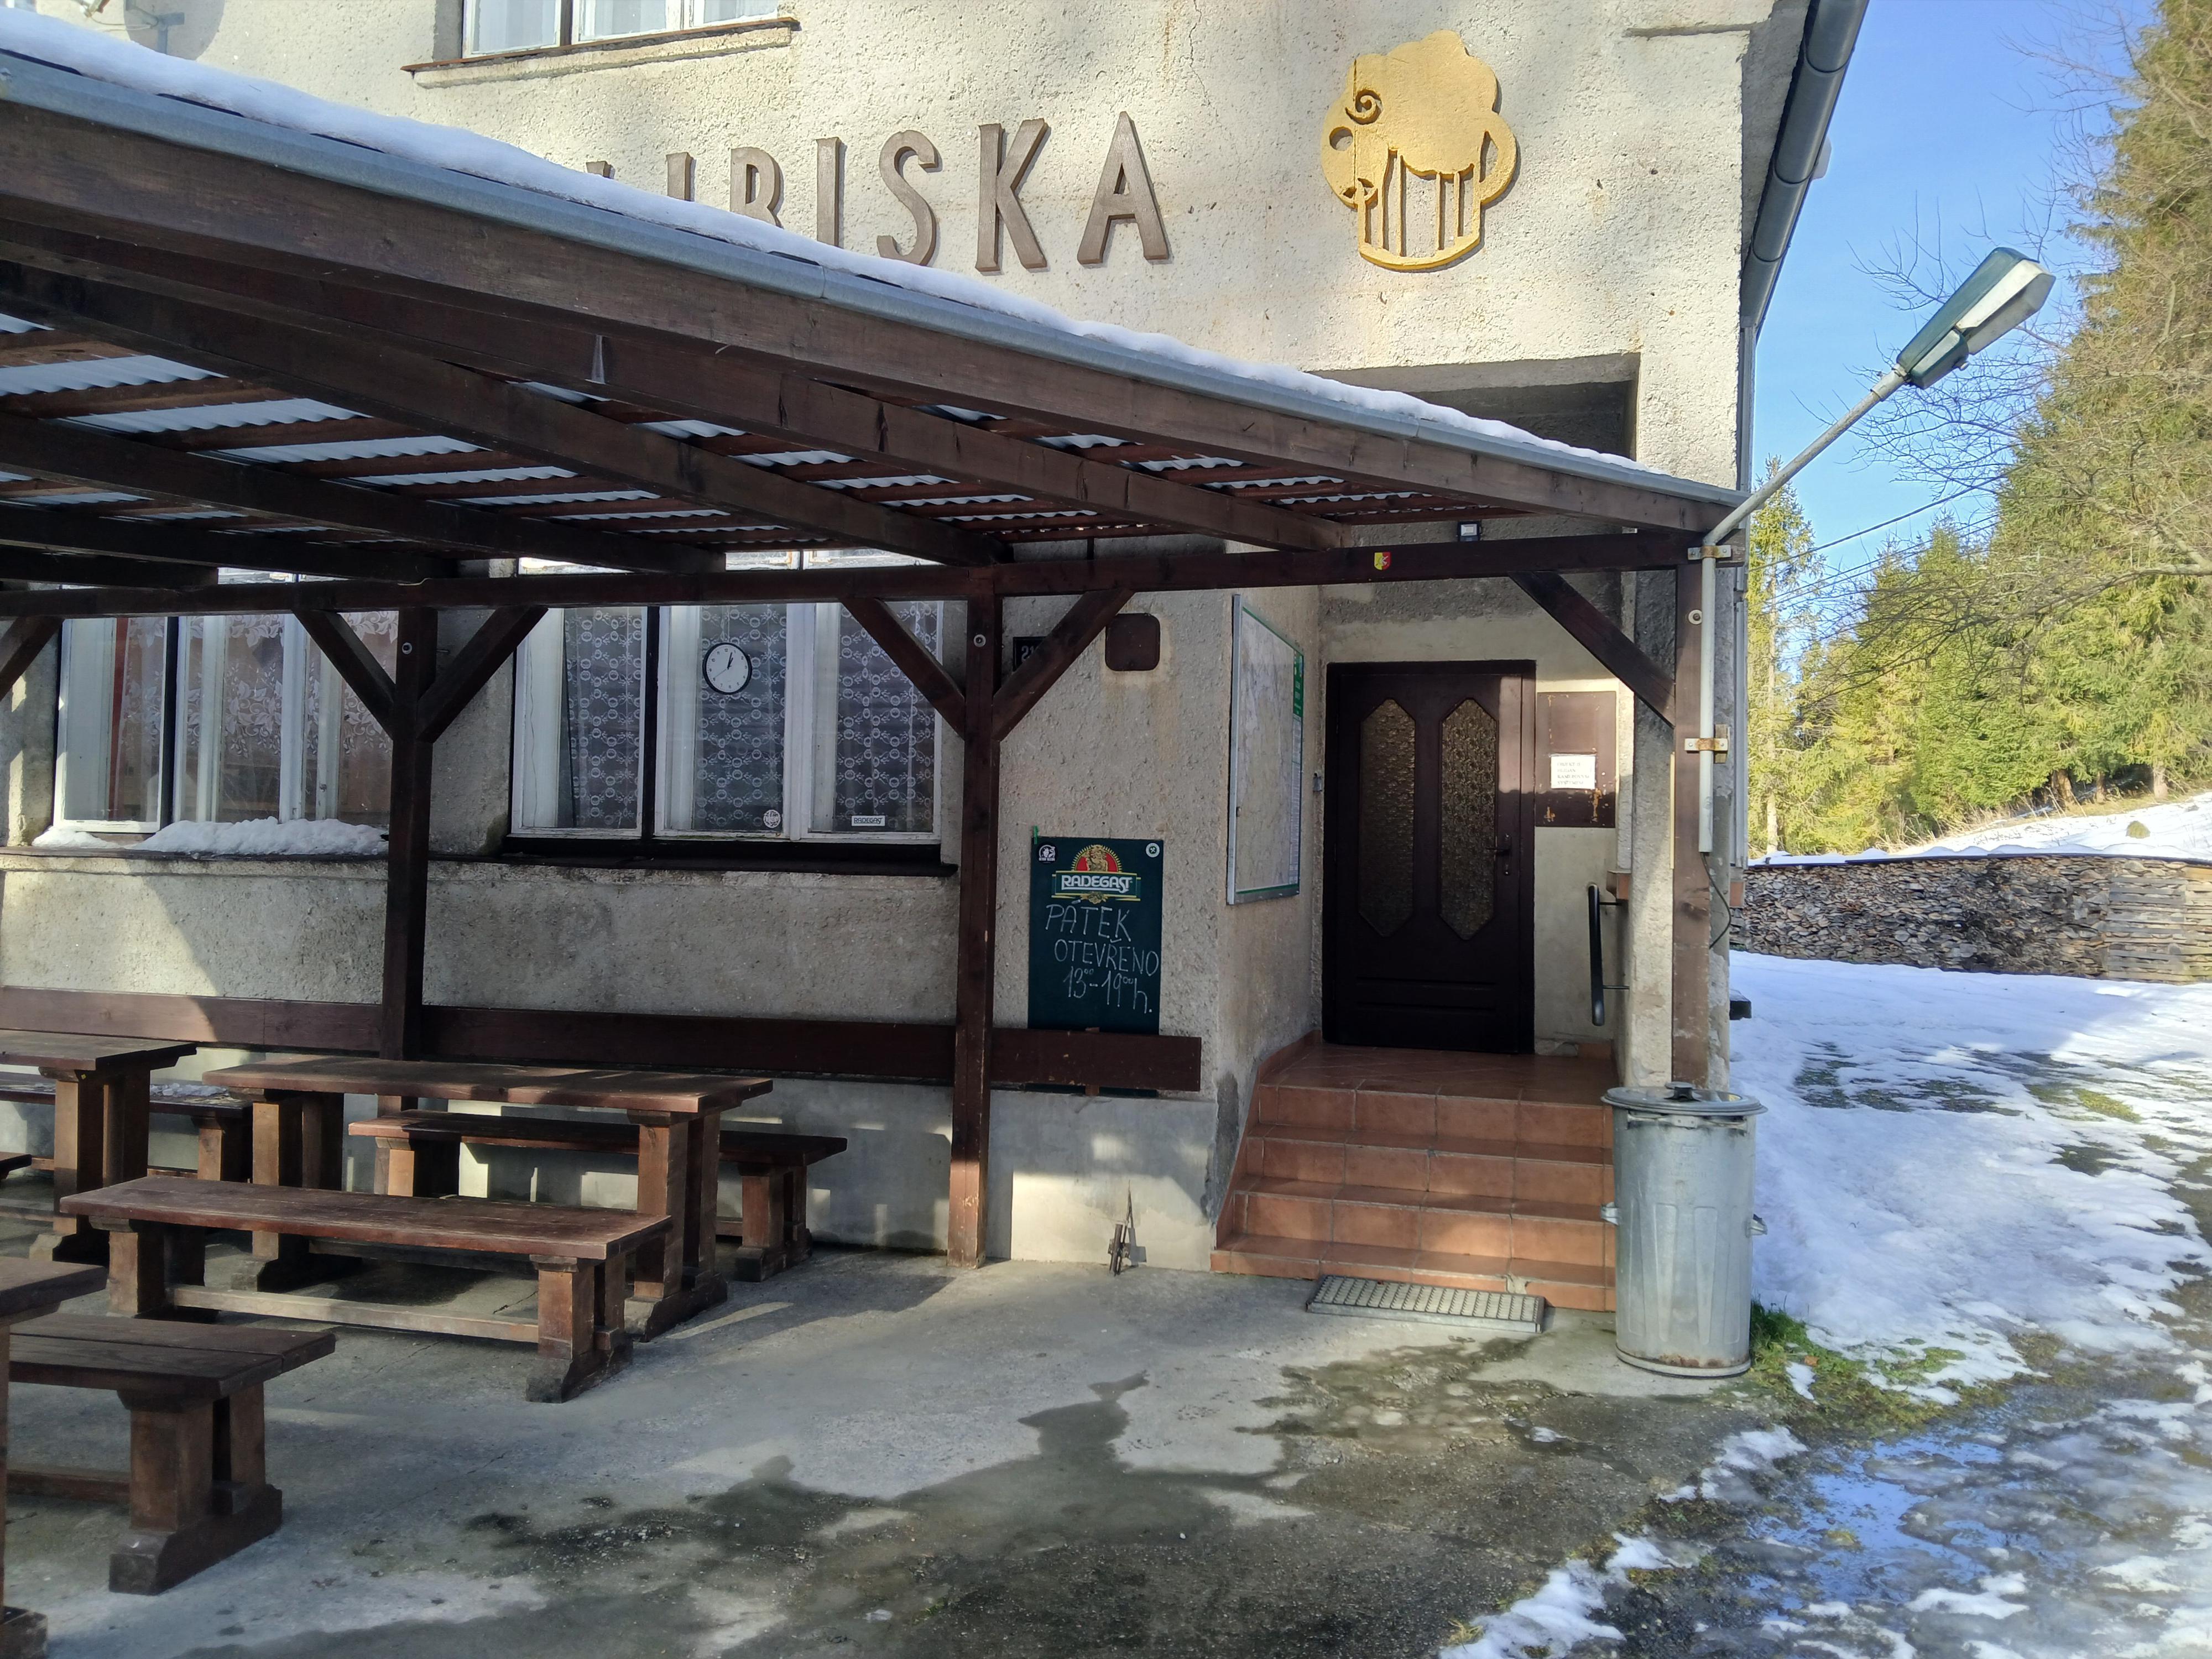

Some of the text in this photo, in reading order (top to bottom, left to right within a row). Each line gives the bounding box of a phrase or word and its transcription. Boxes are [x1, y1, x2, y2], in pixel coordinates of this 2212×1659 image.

[1061, 875, 1133, 893] RADEGAST
[1046, 899, 1131, 942] PÁTEK
[1055, 938, 1159, 977] OTEVŘENO
